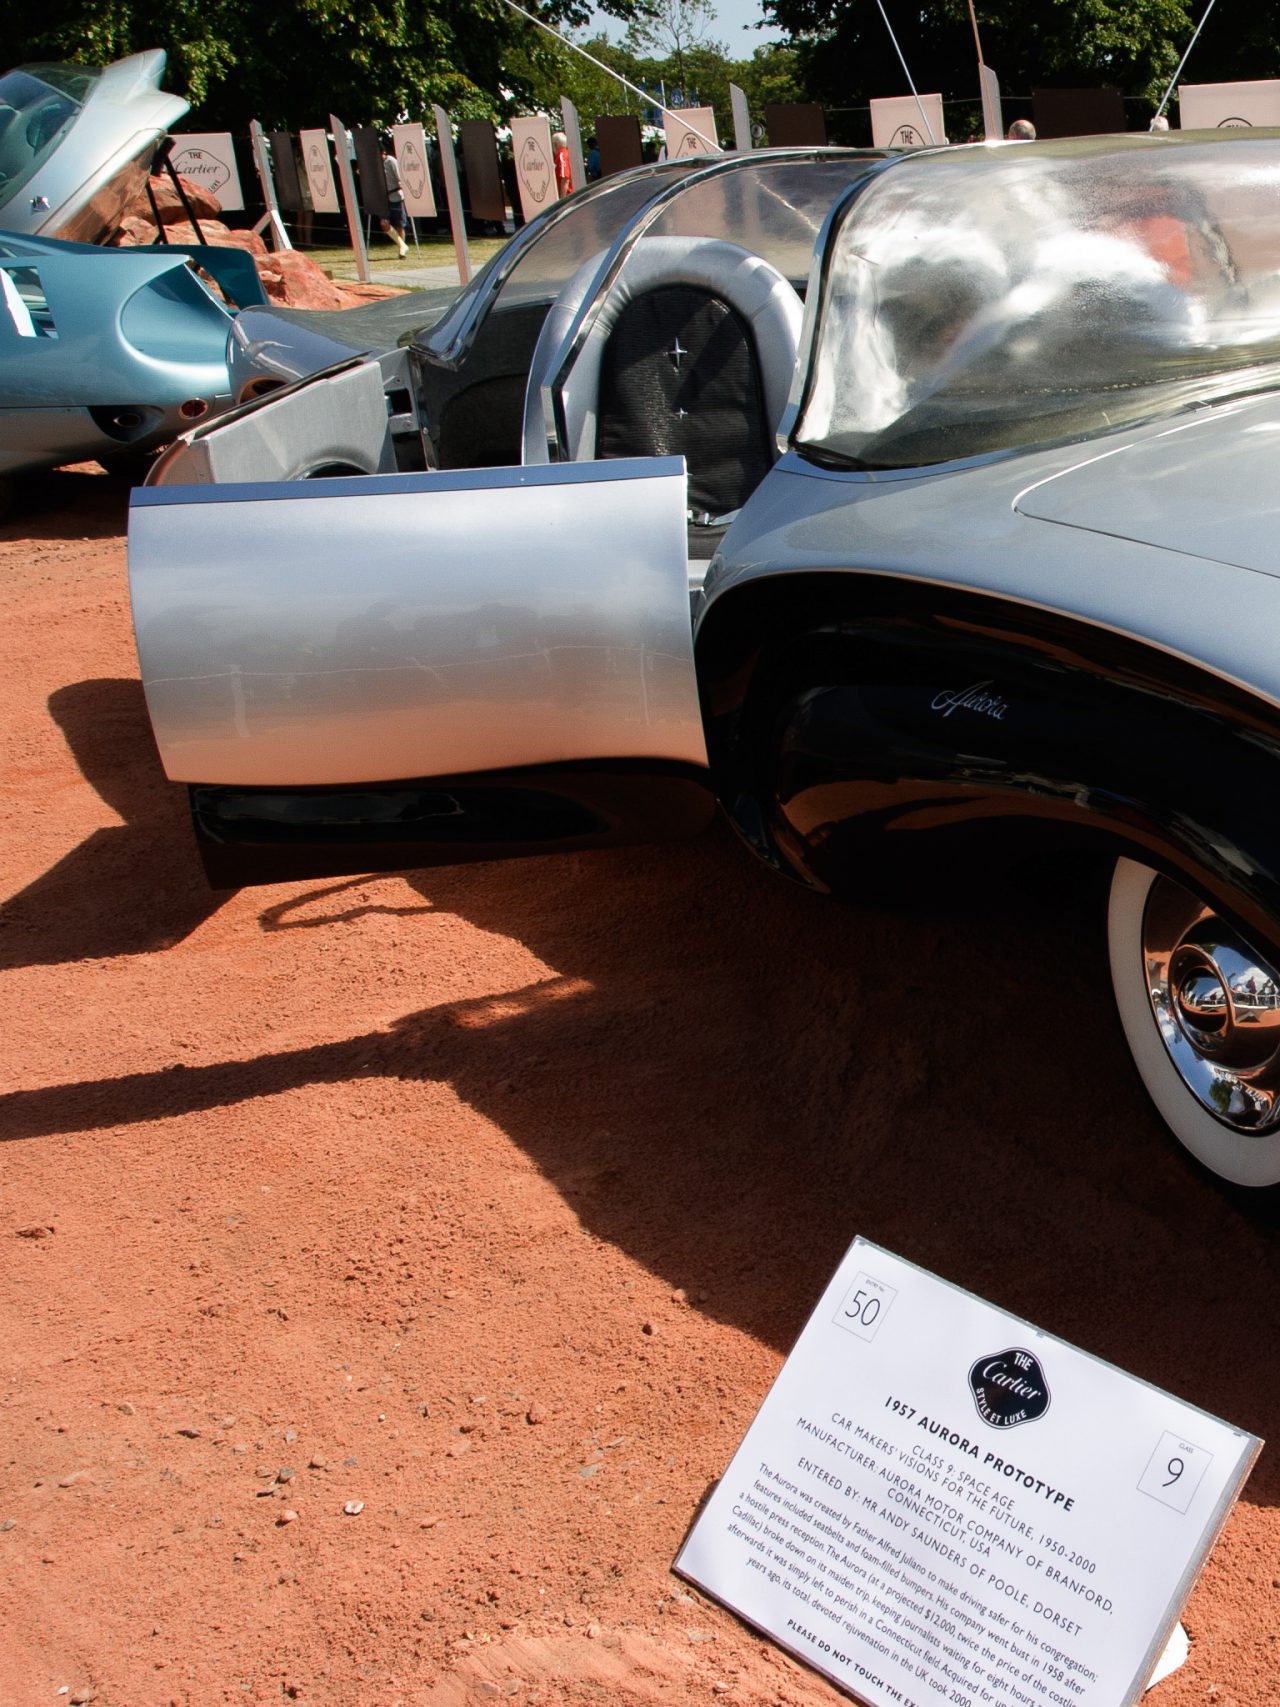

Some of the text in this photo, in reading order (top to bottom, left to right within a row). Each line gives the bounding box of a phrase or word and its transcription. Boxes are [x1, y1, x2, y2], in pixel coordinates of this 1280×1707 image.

[175, 160, 221, 175] Cartier
[188, 151, 203, 160] THE
[900, 130, 913, 144] THE
[845, 1290, 881, 1326] 50
[982, 1361, 1042, 1400] Cartier
[1014, 1352, 1034, 1371] THE
[976, 1387, 1028, 1425] STYLE ET LUXE
[831, 1412, 1096, 1574] CAR MAKERS' VISIONS FOR THE FUTURE, 1950-2000
[885, 1396, 1075, 1512] 1957 AURORA PROTOTYPE
[912, 1445, 1015, 1511] CLASS 9: SPACE AGE
[1162, 1457, 1184, 1487] 9
[797, 1417, 1113, 1615] MANUFACTURER: AURORA MOTOR COMPANY OF BRANFORD,
[797, 1457, 1082, 1636] ENTERED BY: MR ANDY SAUNDERS OF POOLE, DORSET
[887, 1487, 991, 1558] CONNECTICUT, USA
[727, 1523, 766, 1552] afterwards
[765, 1546, 773, 1558] it
[773, 1553, 788, 1567] was
[787, 1563, 811, 1584] simply
[810, 1576, 825, 1592] left
[824, 1587, 835, 1598] to
[832, 1594, 859, 1614] perish
[858, 1608, 868, 1621] in
[867, 1616, 874, 1625] a
[875, 1618, 923, 1657] Connecticut
[940, 1663, 980, 1694] Acquired
[979, 1687, 995, 1703] for
[732, 1504, 764, 1532] Cadillac)
[762, 1524, 785, 1545] broke
[785, 1540, 806, 1559] down
[805, 1555, 817, 1566] on
[816, 1561, 828, 1573] its
[827, 1569, 855, 1591] maiden
[871, 1595, 902, 1624] keeping
[900, 1615, 941, 1648] journalists
[942, 1643, 971, 1670] waiting
[971, 1661, 986, 1676] for
[986, 1673, 1009, 1692] eight
[1009, 1684, 1036, 1707] hours
[738, 1491, 745, 1500] a
[745, 1493, 770, 1516] hostile
[768, 1511, 790, 1528] press
[826, 1544, 841, 1561] The
[839, 1555, 867, 1579] Aurora
[867, 1573, 880, 1587] (at
[879, 1582, 886, 1591] a
[884, 1586, 925, 1615] projected
[924, 1608, 956, 1638] $12,000,
[956, 1632, 980, 1652] twice
[981, 1647, 996, 1662] the
[995, 1658, 1020, 1677] price
[1021, 1673, 1034, 1684] of
[1032, 1679, 1048, 1694] the
[753, 1479, 782, 1504] features
[782, 1498, 814, 1523] included
[812, 1519, 845, 1544] seatbelts
[845, 1540, 862, 1553] and
[860, 1547, 901, 1579] foam-filled
[935, 1594, 949, 1611] His
[950, 1607, 986, 1636] company
[987, 1630, 1010, 1649] went
[1009, 1641, 1030, 1662] bust
[1030, 1655, 1040, 1668] in
[1042, 1662, 1065, 1682] 1958
[1063, 1678, 1086, 1695] after
[759, 1462, 1098, 1683] The Aurora was created by Father Alfred Juliano to make driving safer for his congregation;
[745, 1557, 768, 1574] years
[767, 1570, 781, 1585] ago,
[781, 1577, 792, 1591] its
[811, 1599, 843, 1624] devoted
[841, 1620, 890, 1656] rejuvenation
[890, 1650, 900, 1663] in
[900, 1657, 914, 1672] the
[914, 1665, 930, 1683] UK
[928, 1677, 949, 1696] took
[786, 1618, 817, 1644] PLEASE
[817, 1639, 831, 1653] DO
[831, 1649, 853, 1666] NOT
[854, 1663, 885, 1689] TOUCH
[886, 1684, 904, 1702] THE
